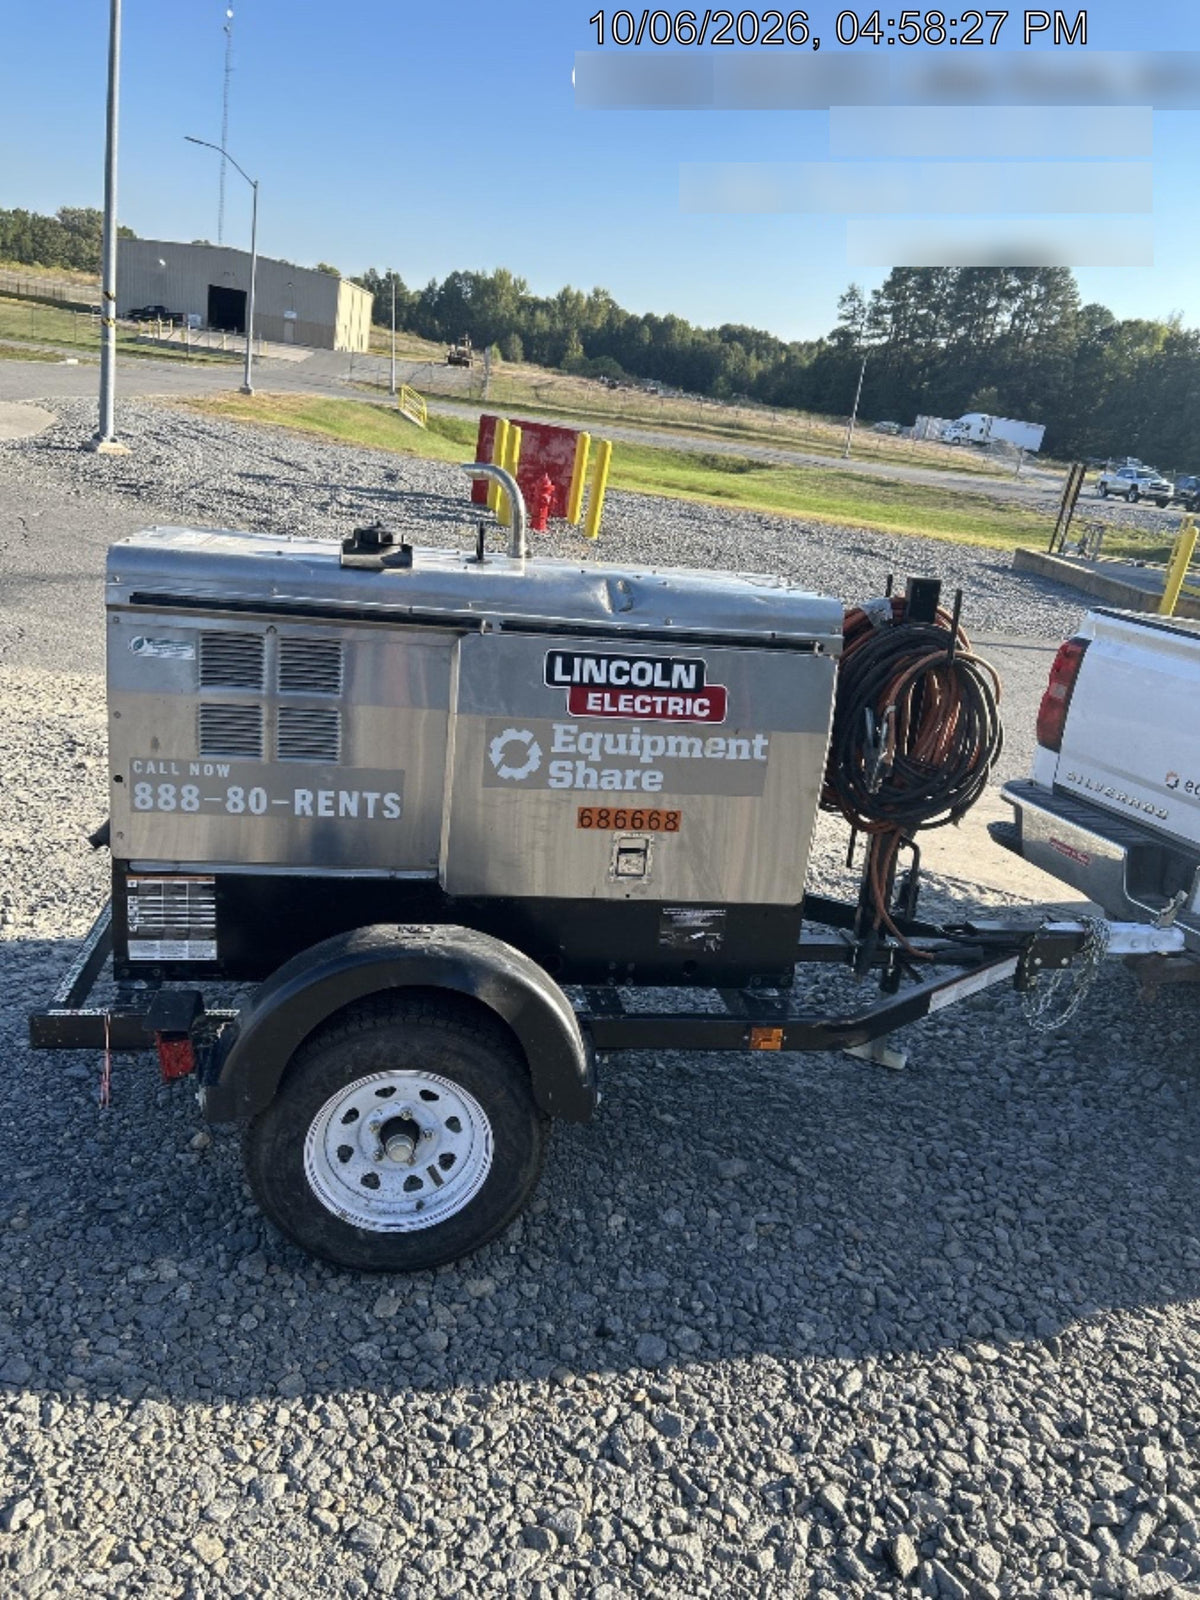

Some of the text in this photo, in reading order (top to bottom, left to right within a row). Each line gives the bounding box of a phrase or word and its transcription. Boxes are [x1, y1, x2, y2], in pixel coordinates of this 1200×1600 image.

[554, 656, 697, 688] LINCOLN
[586, 692, 711, 717] ELECTRIC
[551, 724, 769, 763] Equipment
[132, 761, 231, 778] CALL NOW
[549, 760, 664, 792] Share
[134, 782, 402, 819] 888-80-RENTS
[580, 808, 680, 831] 686668
